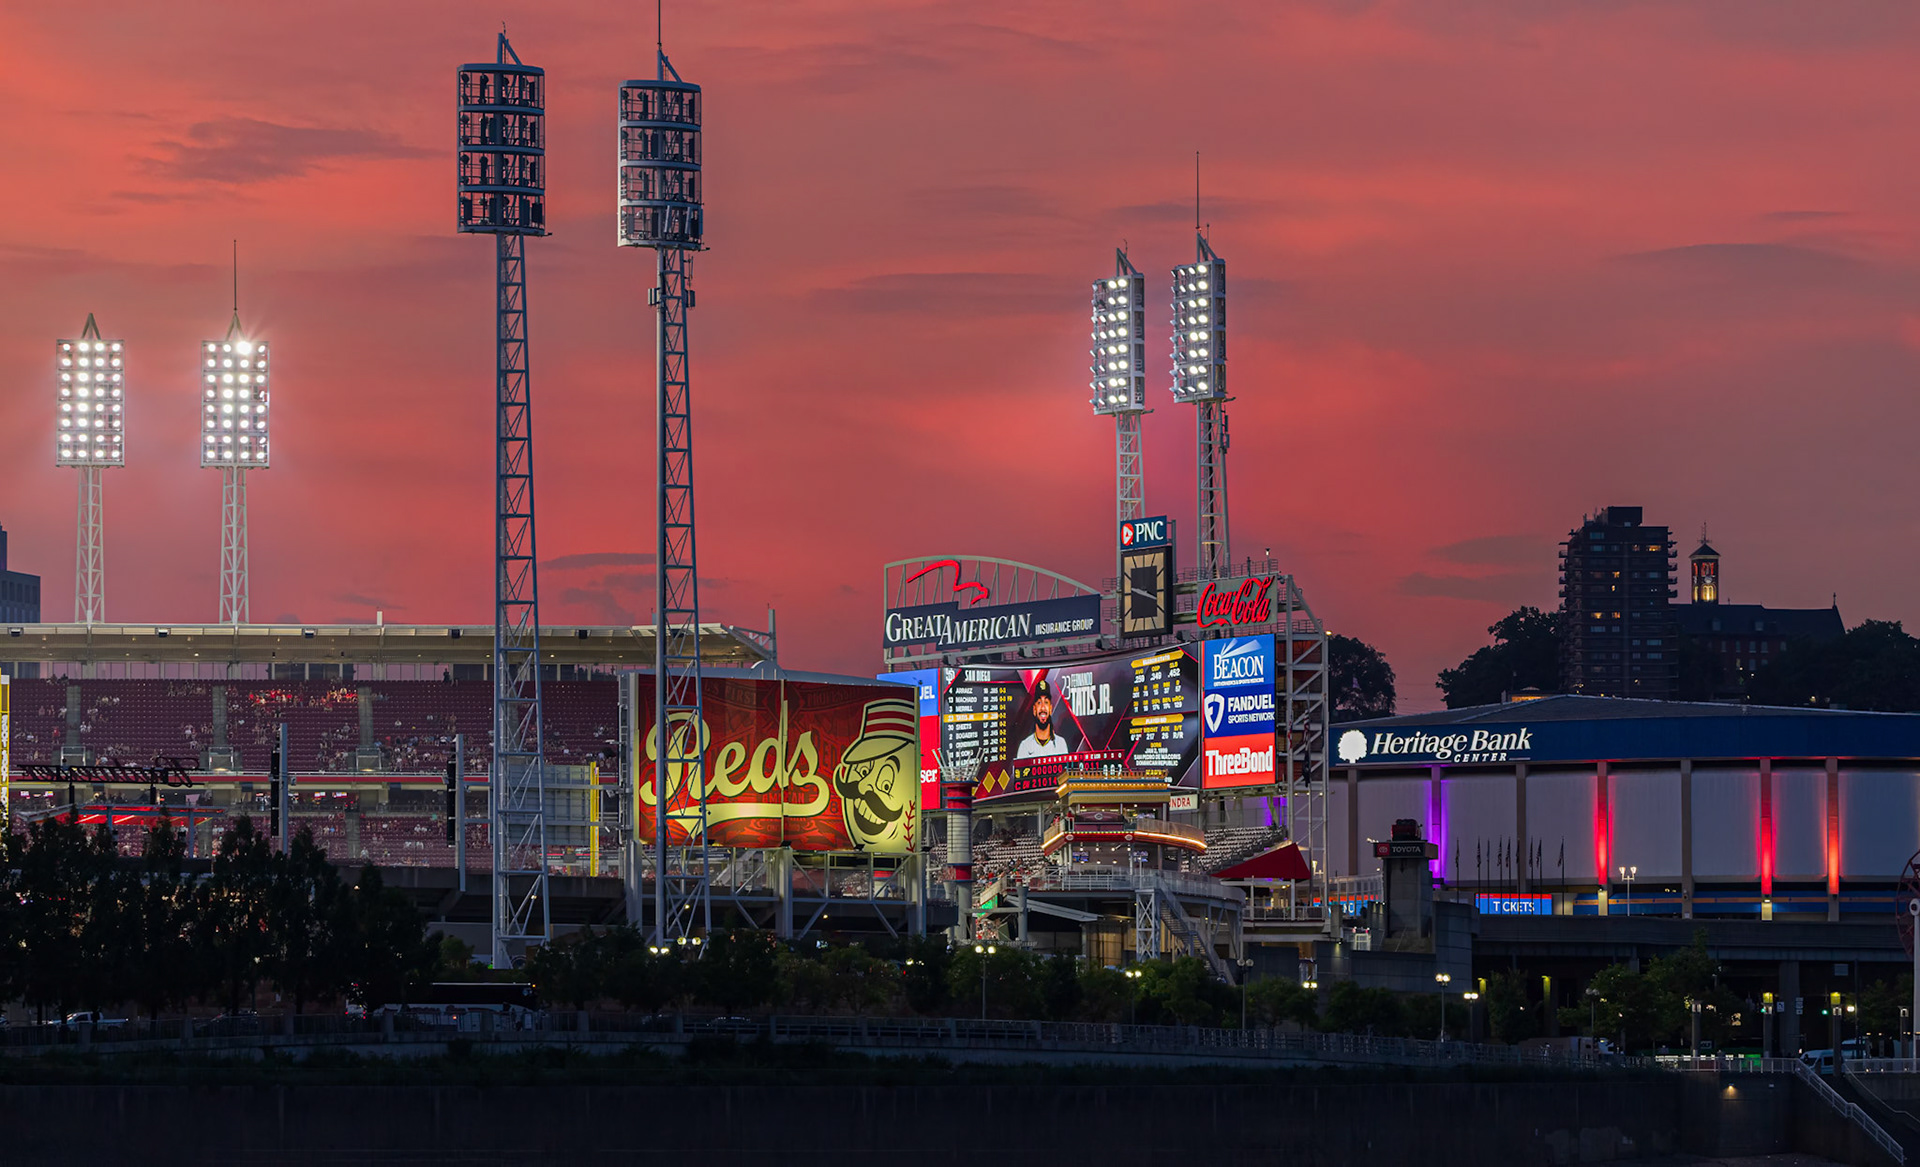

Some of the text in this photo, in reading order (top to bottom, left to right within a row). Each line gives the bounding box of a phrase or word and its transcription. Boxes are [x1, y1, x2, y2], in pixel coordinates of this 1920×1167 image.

[1135, 520, 1163, 542] PNC
[1196, 576, 1275, 628] Coca-Cola
[886, 613, 1094, 646] GREAT AMERICAN INSURANCE GROUP
[1213, 654, 1264, 679] BEACON
[1071, 684, 1113, 716] TATIS JR.
[1228, 694, 1275, 712] FANDUEL
[1228, 712, 1275, 724] SPORTS NETWORK
[1370, 727, 1533, 760] Heritage Bank
[639, 699, 828, 818] Reds
[1205, 745, 1273, 776] ThreeBond
[1454, 753, 1507, 763] CENTER
[1493, 901, 1535, 912] TCKETS
